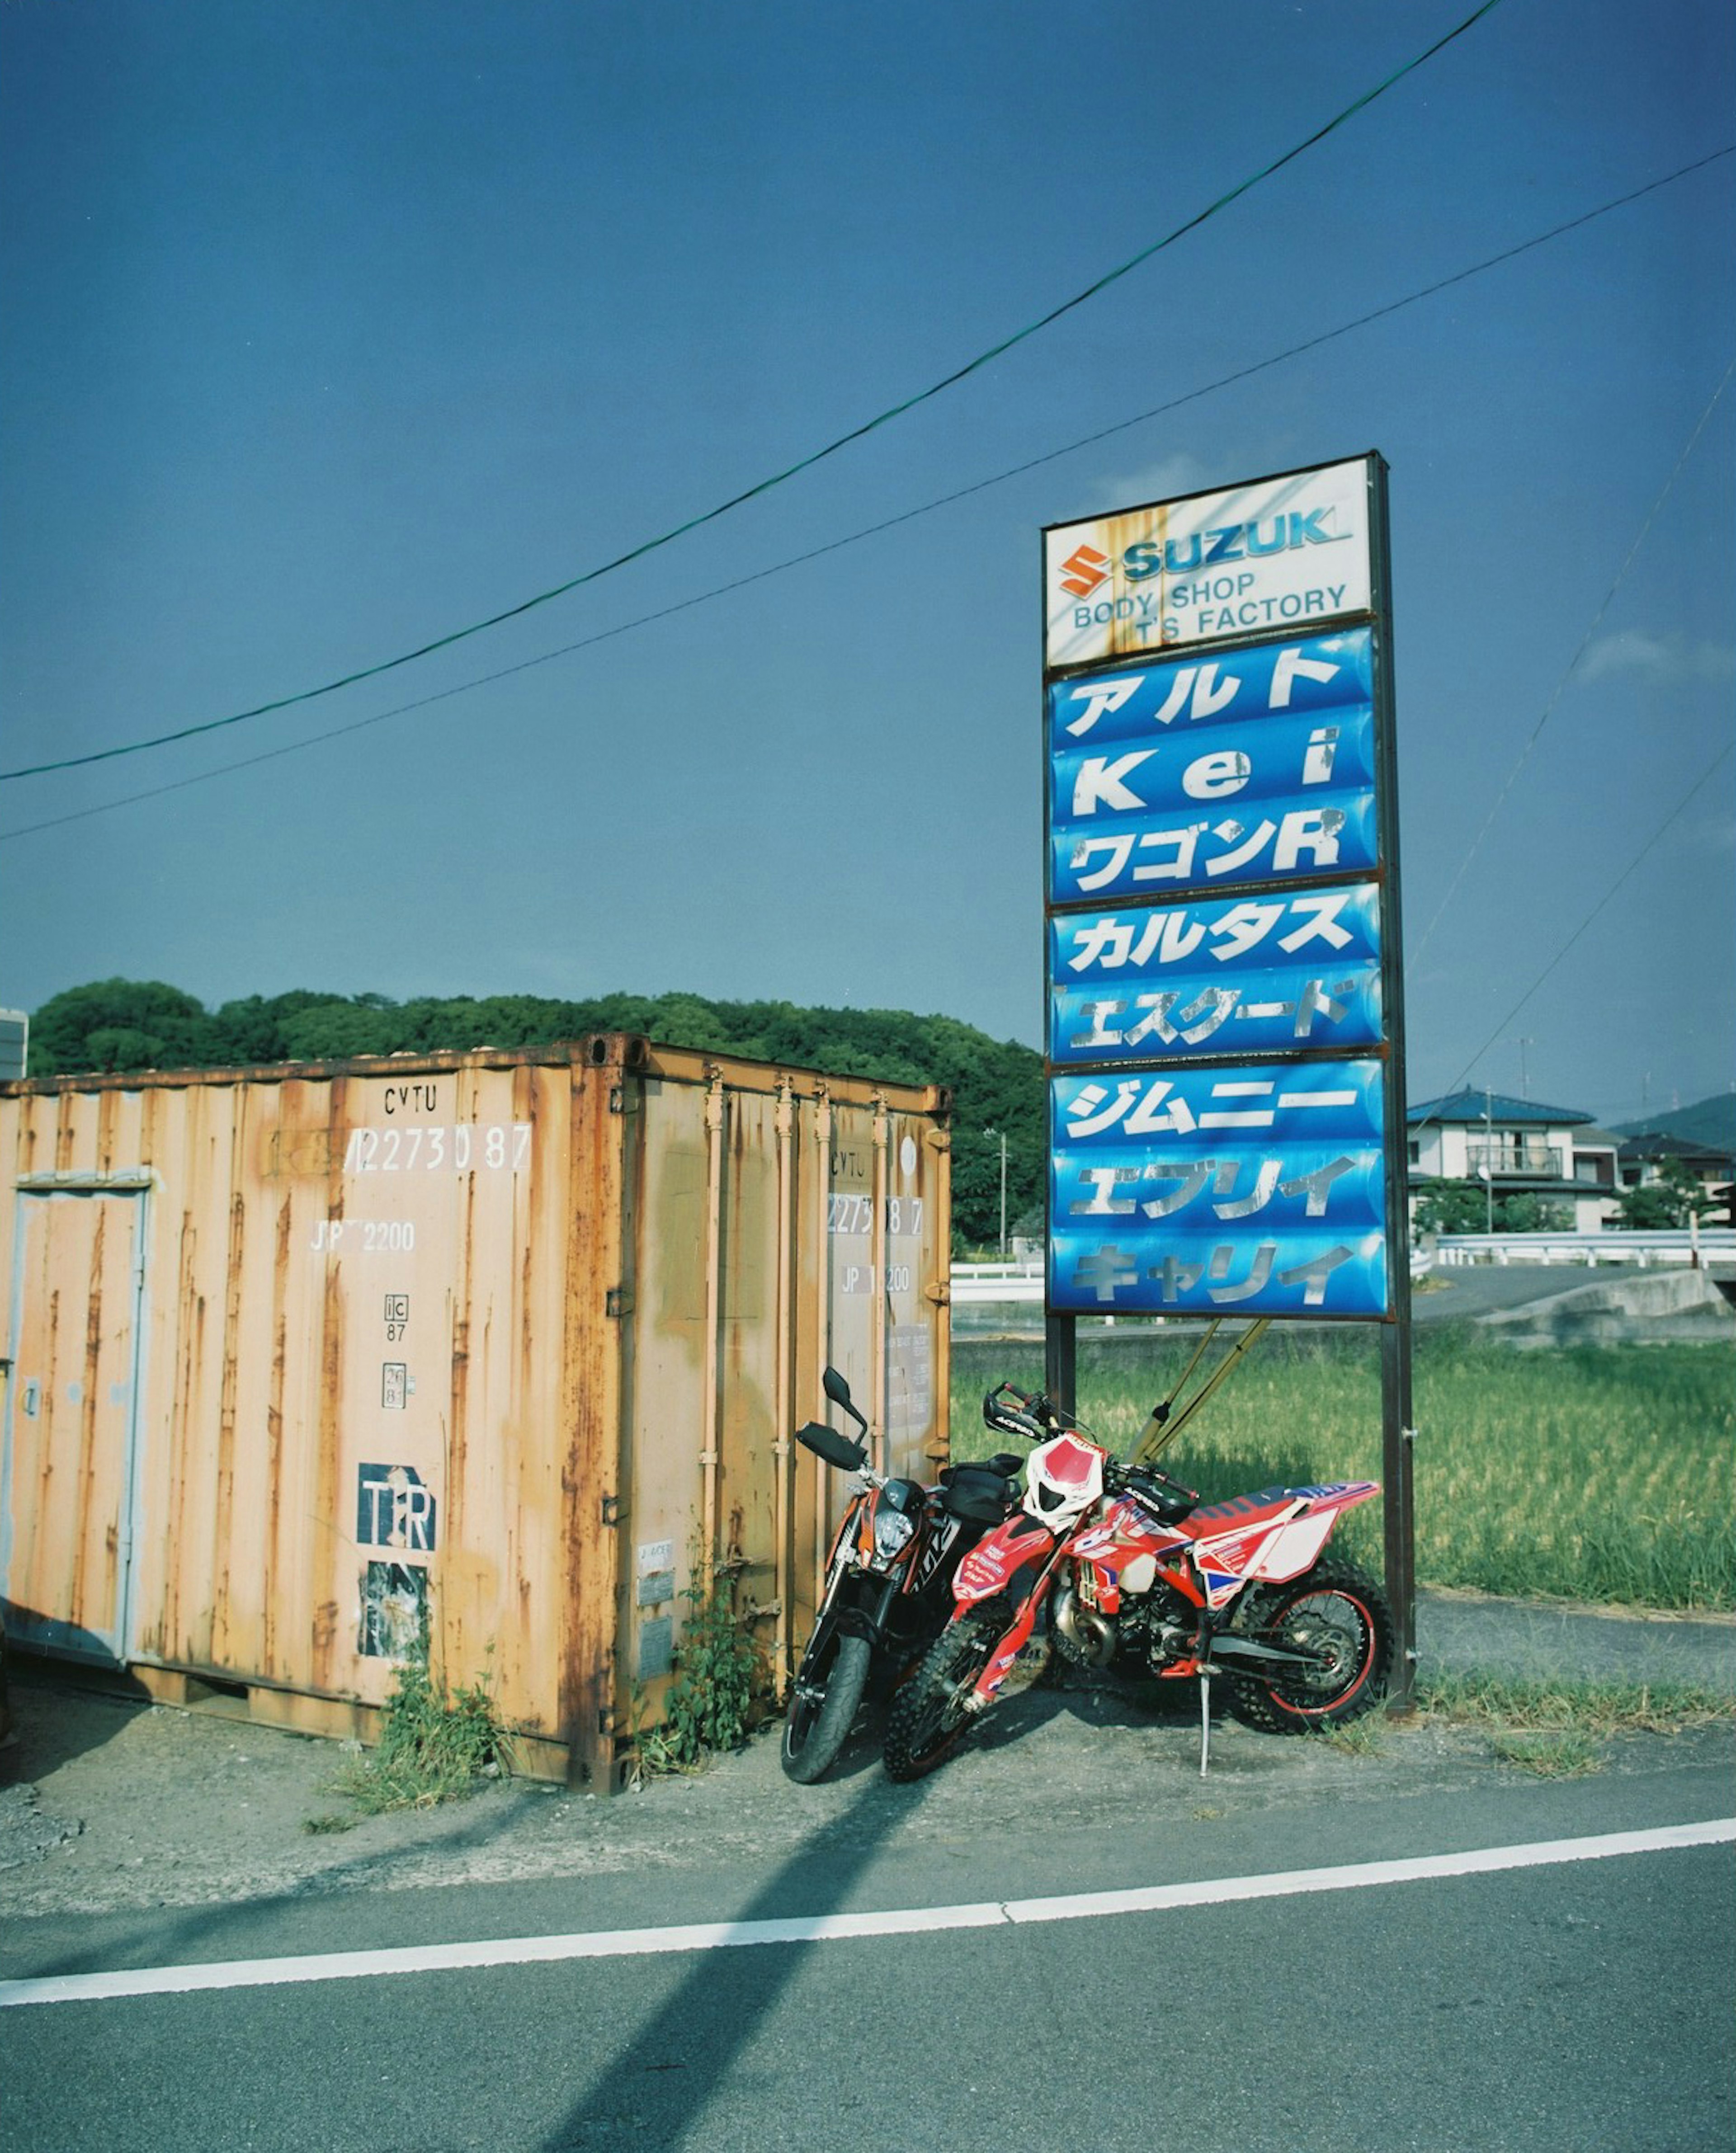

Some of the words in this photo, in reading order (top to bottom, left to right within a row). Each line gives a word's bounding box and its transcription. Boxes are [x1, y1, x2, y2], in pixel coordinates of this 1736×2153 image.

[1123, 505, 1353, 581] SUZUK
[1074, 591, 1153, 629] BODY
[1172, 572, 1255, 609] SHOP
[1136, 617, 1179, 645] T'S
[1198, 584, 1346, 634] FACTORY
[1065, 647, 1341, 737] アルト
[1072, 726, 1340, 817] Kei
[1070, 808, 1345, 892] ワゴンR
[1068, 894, 1354, 972] カルタス
[1070, 980, 1354, 1048] エスクード
[385, 1085, 437, 1114] CVTU
[1066, 1079, 1357, 1138] ジムニー
[1069, 1156, 1356, 1220] エブリイ
[311, 1220, 343, 1251] JP
[363, 1222, 415, 1251] 2200
[842, 1266, 859, 1293] JP
[1071, 1244, 1354, 1305] キャリイ
[387, 1324, 405, 1342] 87
